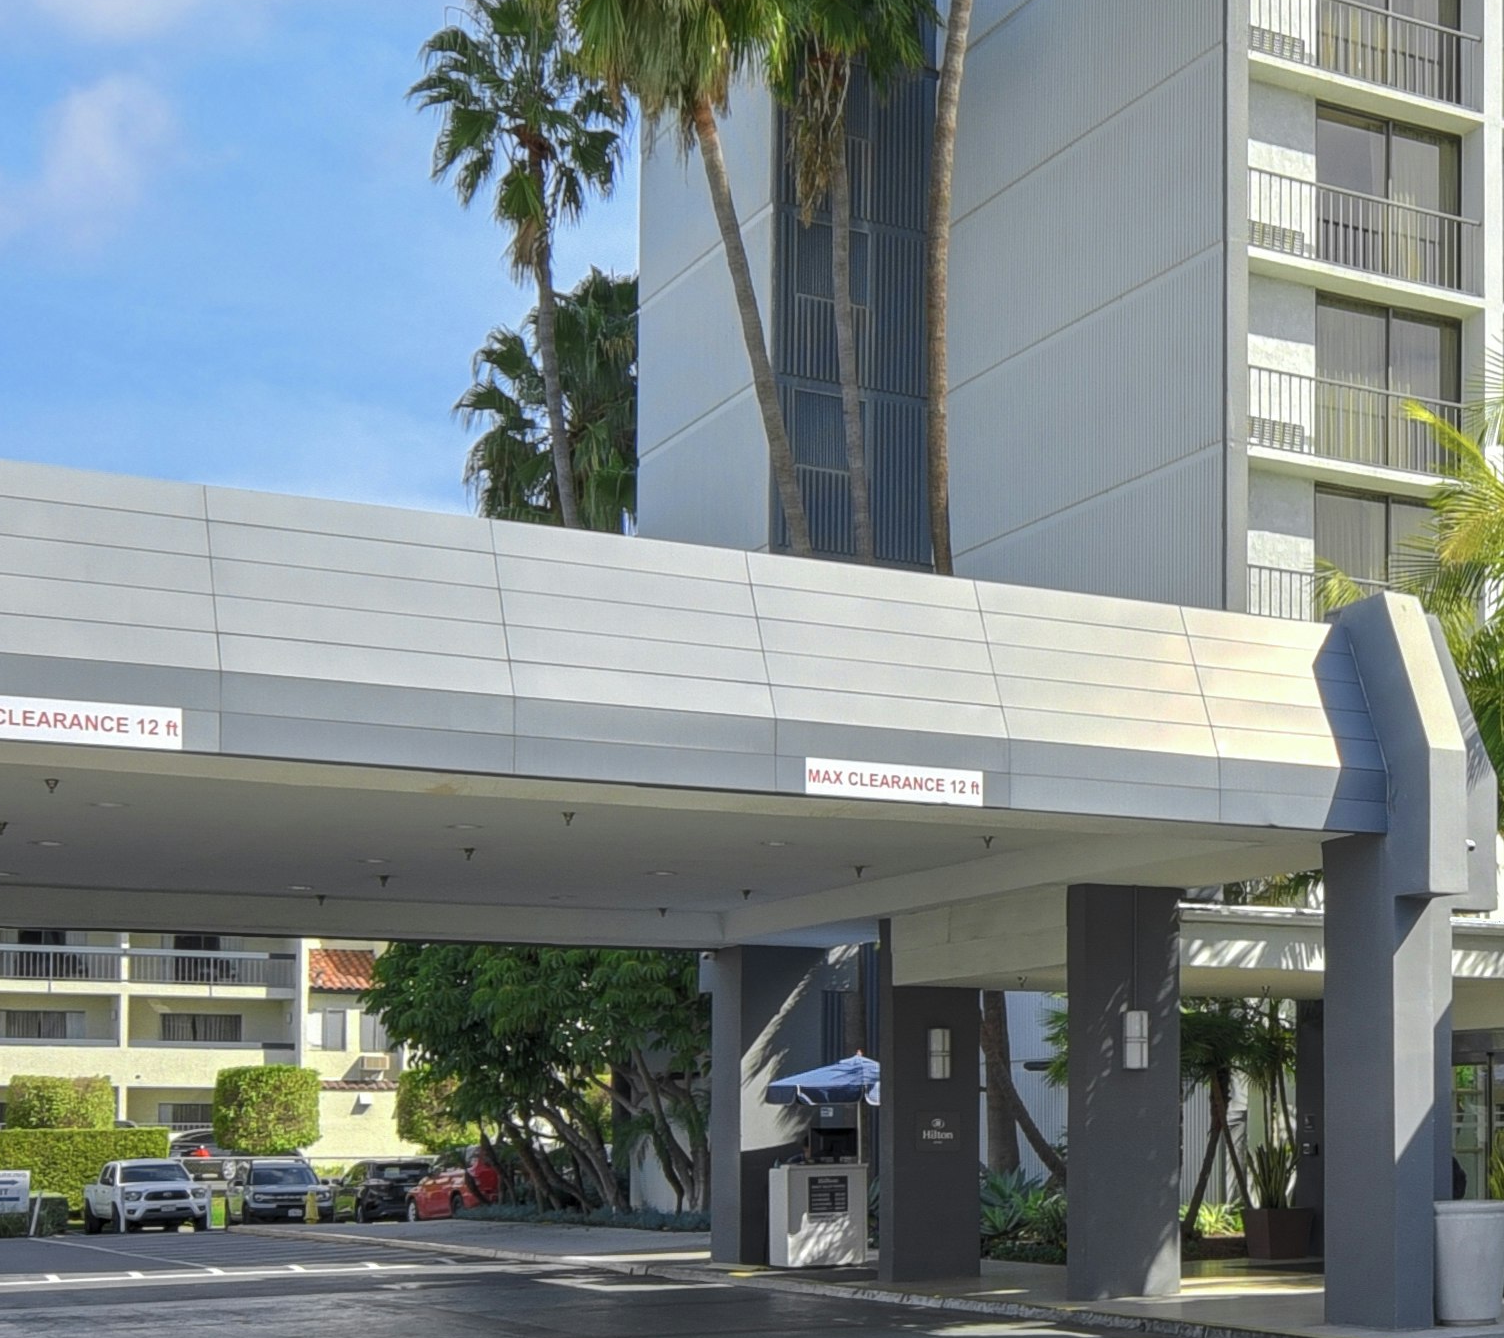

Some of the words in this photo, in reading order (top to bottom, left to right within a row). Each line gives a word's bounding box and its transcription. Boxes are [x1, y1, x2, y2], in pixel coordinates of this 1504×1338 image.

[137, 718, 159, 736] 12
[166, 720, 179, 737] ft
[808, 769, 844, 785] MAX
[848, 772, 946, 793] CLEARANCE
[950, 780, 966, 794] 12
[971, 781, 980, 795] ft
[922, 1130, 954, 1139] Hilton
